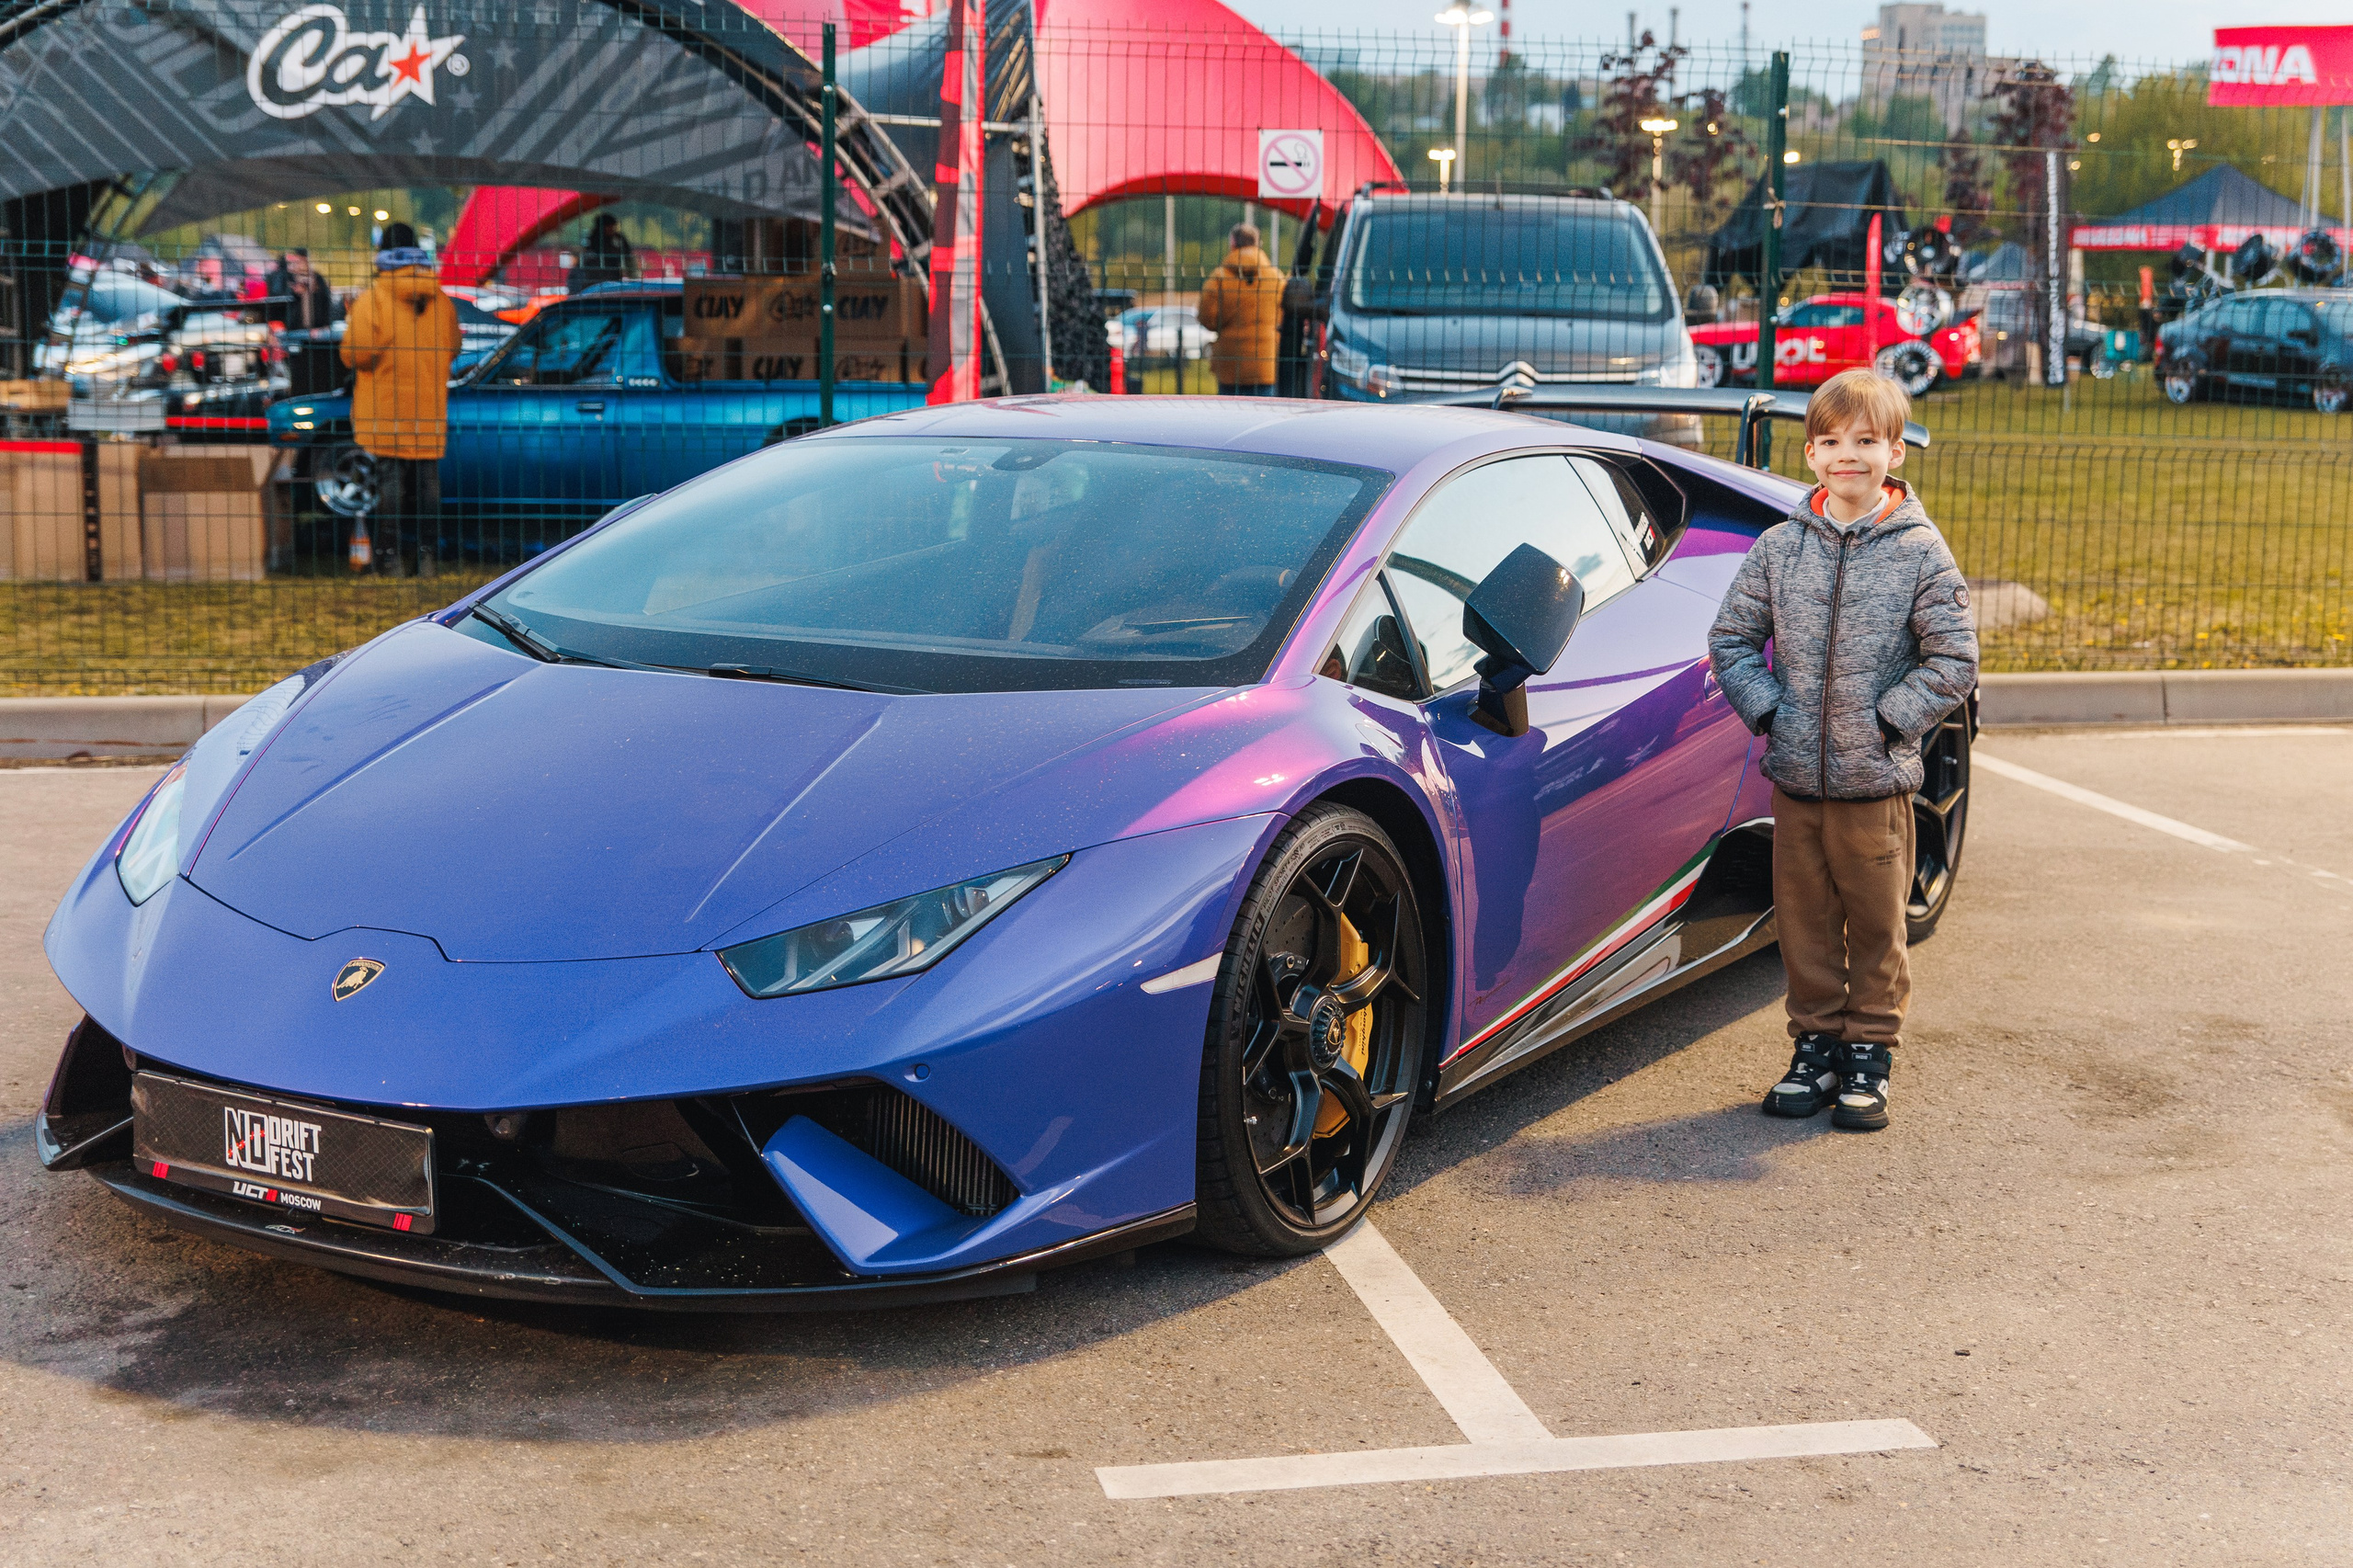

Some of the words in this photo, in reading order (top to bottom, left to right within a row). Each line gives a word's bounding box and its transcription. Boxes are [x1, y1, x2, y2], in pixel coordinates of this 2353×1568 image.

[836, 293, 889, 321] CLAY
[1732, 336, 1826, 369] UOL
[1234, 919, 1263, 1014] MICHELIN
[268, 1115, 322, 1153] DRIFT
[269, 1145, 314, 1182] FEST
[233, 1181, 269, 1199] UCT
[280, 1192, 322, 1211] MOSCOW
